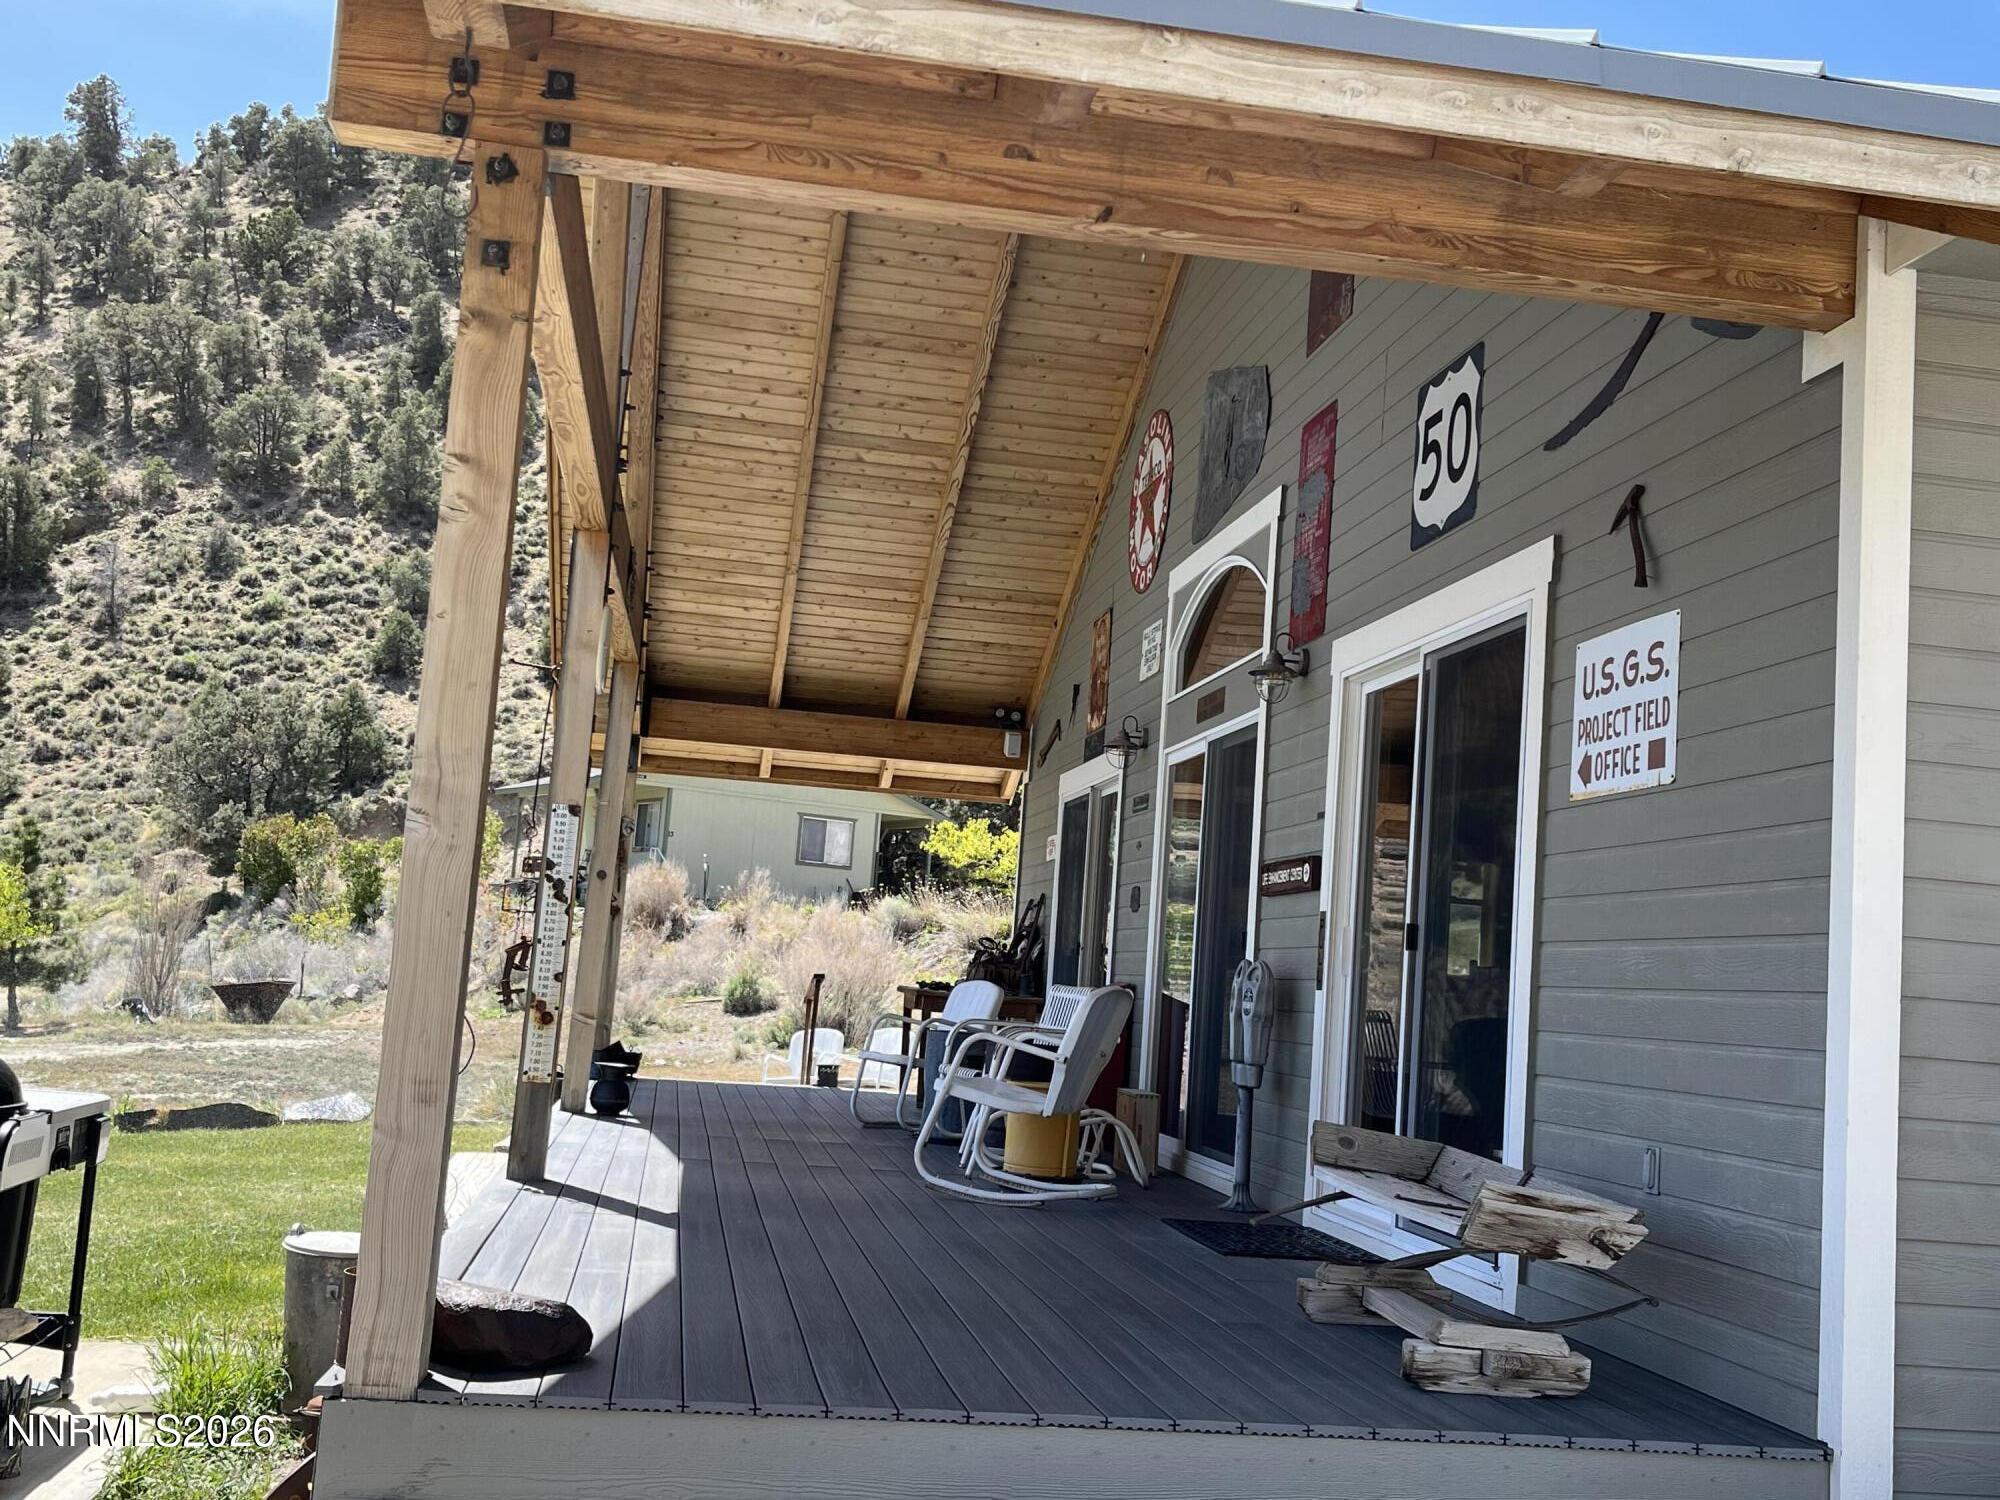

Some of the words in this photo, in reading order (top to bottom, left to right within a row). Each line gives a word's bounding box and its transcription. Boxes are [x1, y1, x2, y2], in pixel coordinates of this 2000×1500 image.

[1142, 459, 1162, 489] TECO
[1419, 392, 1472, 501] 50
[1129, 526, 1154, 590] MOTOR
[1583, 640, 1670, 700] U.S.G.S.
[1577, 704, 1632, 747] PROJECT
[1635, 695, 1671, 734] FIELD
[1594, 743, 1641, 782] OFFICE
